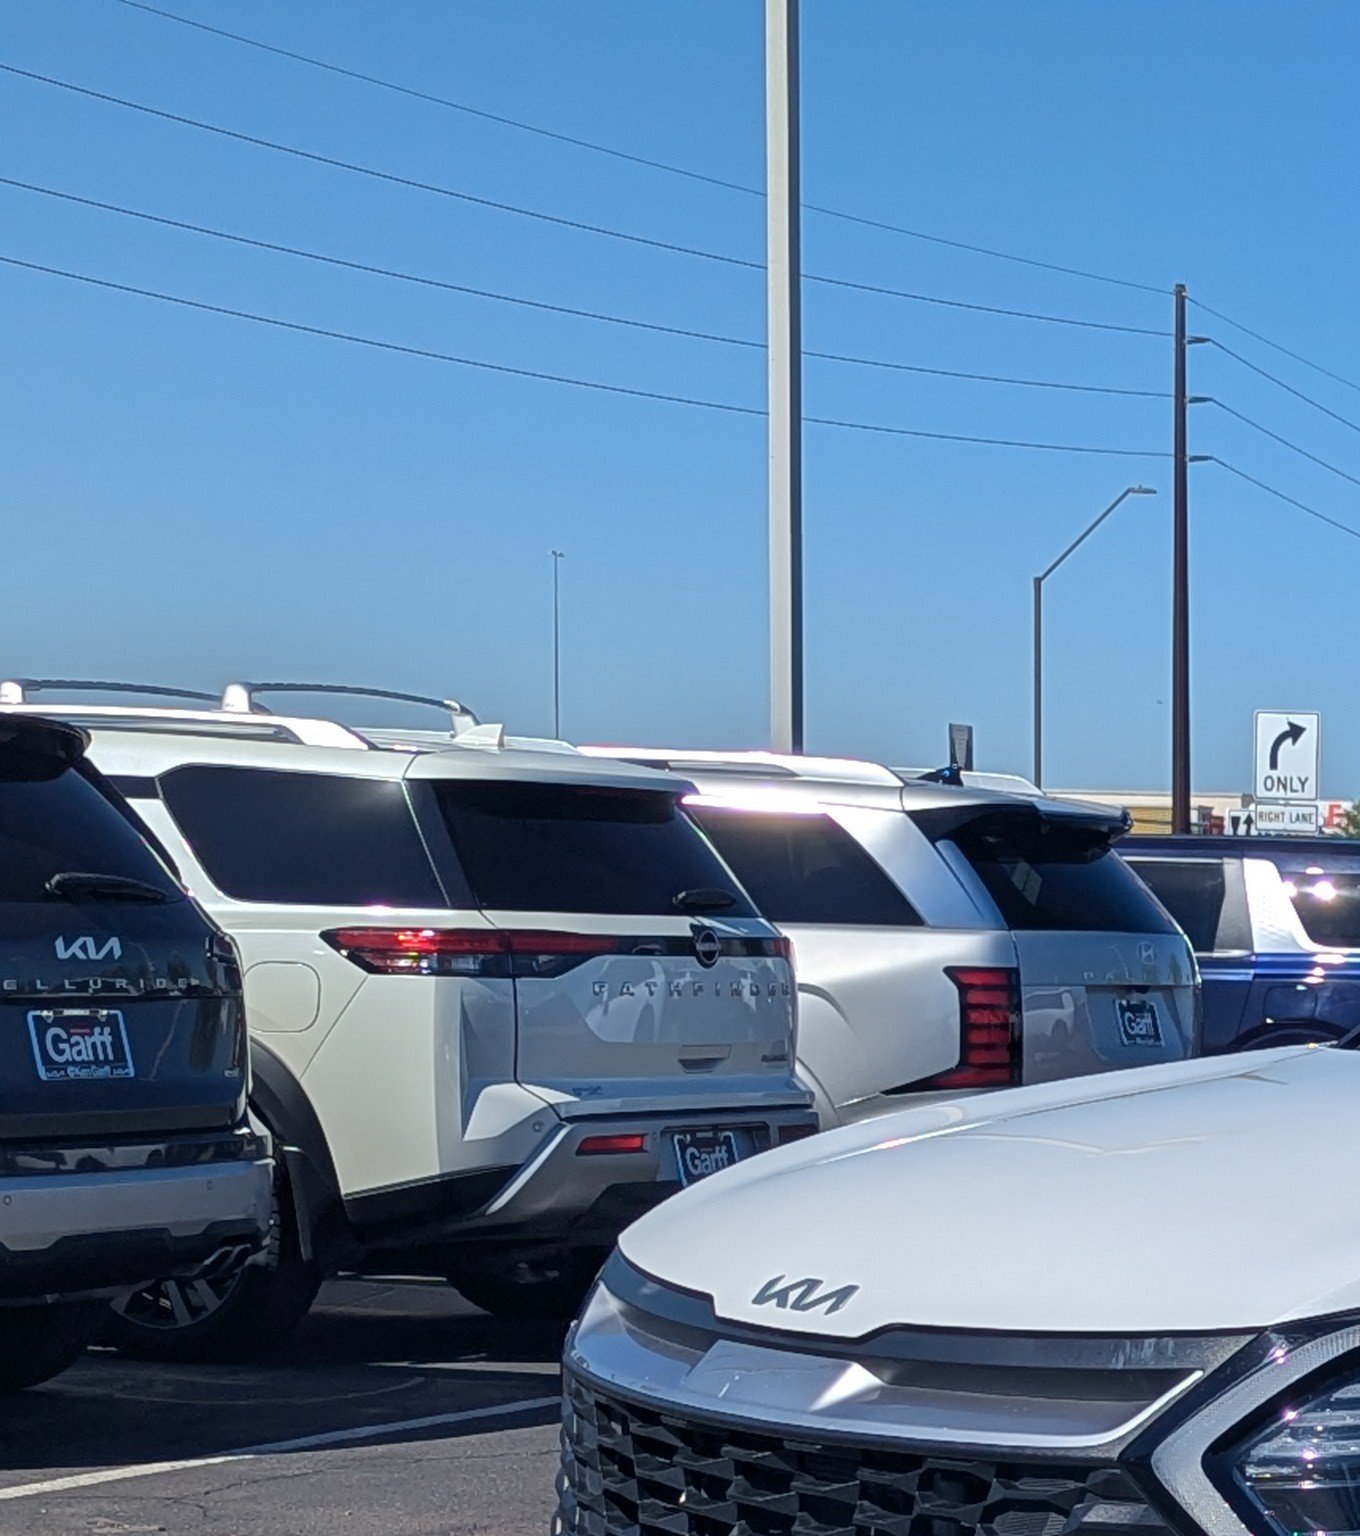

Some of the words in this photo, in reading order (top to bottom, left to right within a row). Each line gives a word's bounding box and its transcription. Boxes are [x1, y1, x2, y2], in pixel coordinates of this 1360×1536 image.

[1263, 775, 1310, 794] ONLY
[1258, 810, 1286, 823] RIGHT
[1289, 811, 1315, 825] LANE
[54, 934, 122, 960] KIA
[45, 1026, 114, 1063] Garff
[685, 1146, 730, 1175] Garff
[751, 1274, 861, 1316] KIA
